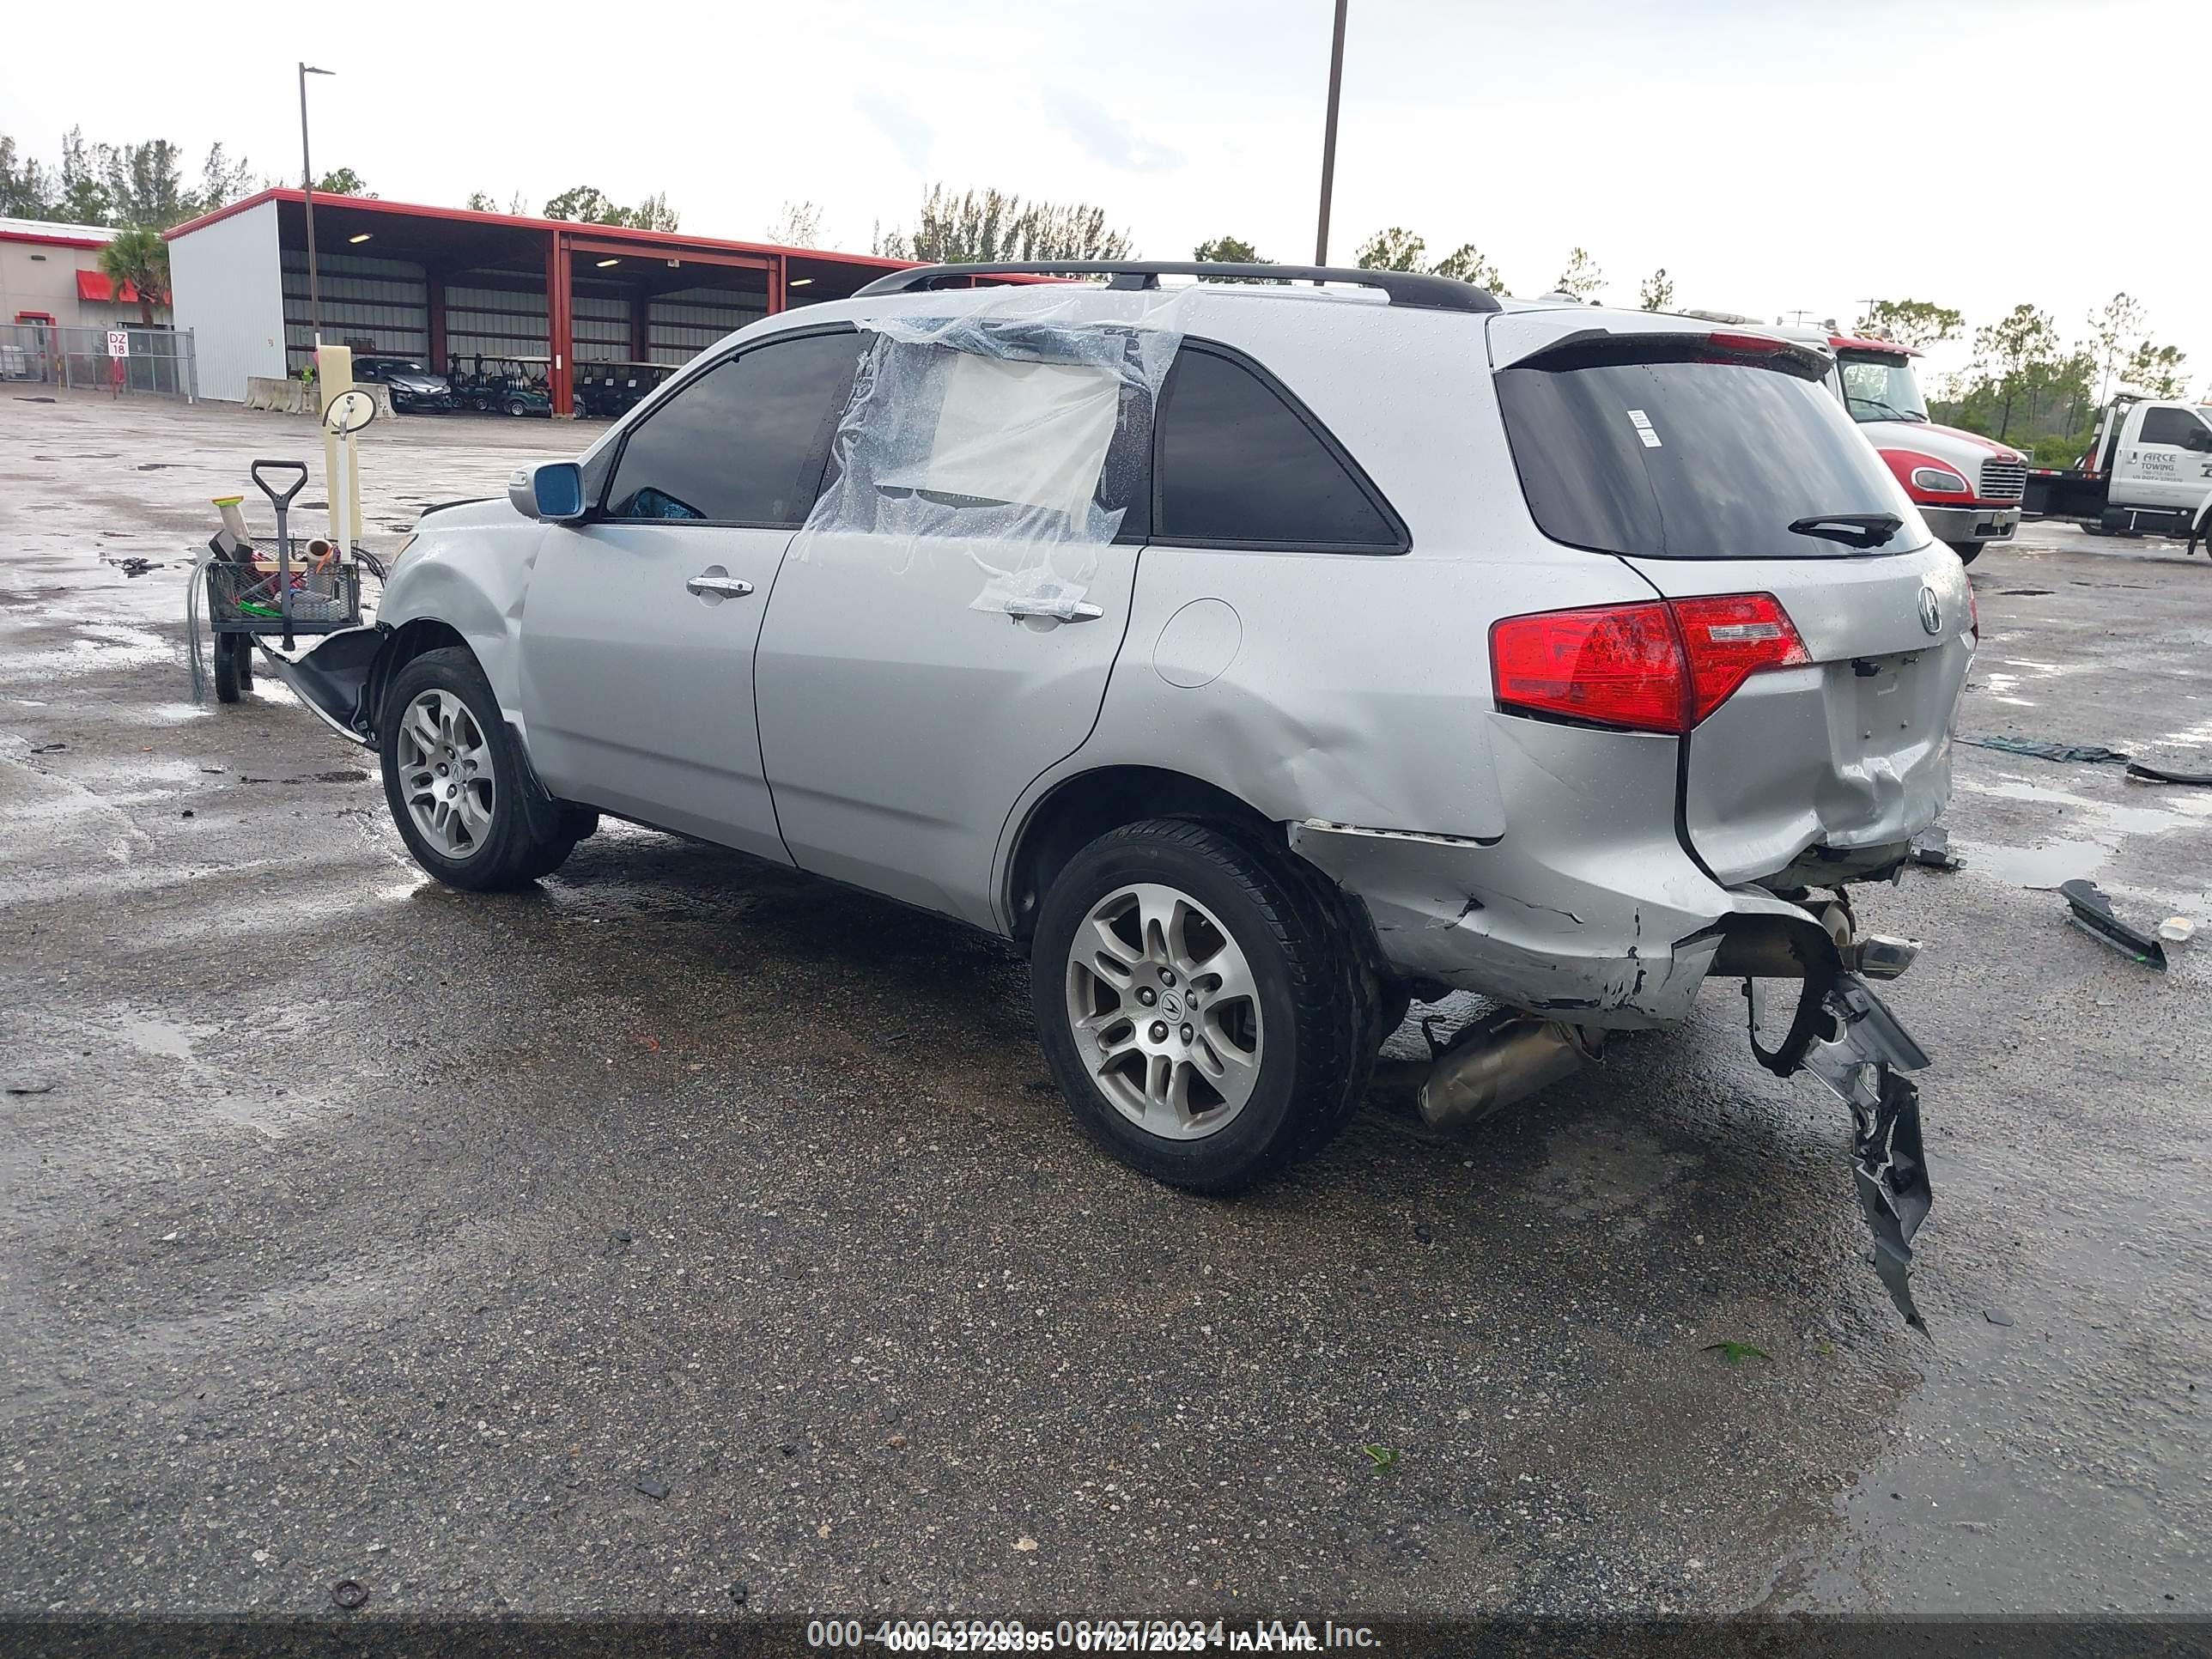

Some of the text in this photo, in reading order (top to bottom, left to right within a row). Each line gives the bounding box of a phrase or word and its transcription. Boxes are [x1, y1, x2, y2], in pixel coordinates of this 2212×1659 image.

[109, 333, 126, 344] DZ
[113, 344, 125, 355] 18
[2143, 453, 2178, 462] ARCE
[2142, 463, 2174, 471] TOWING
